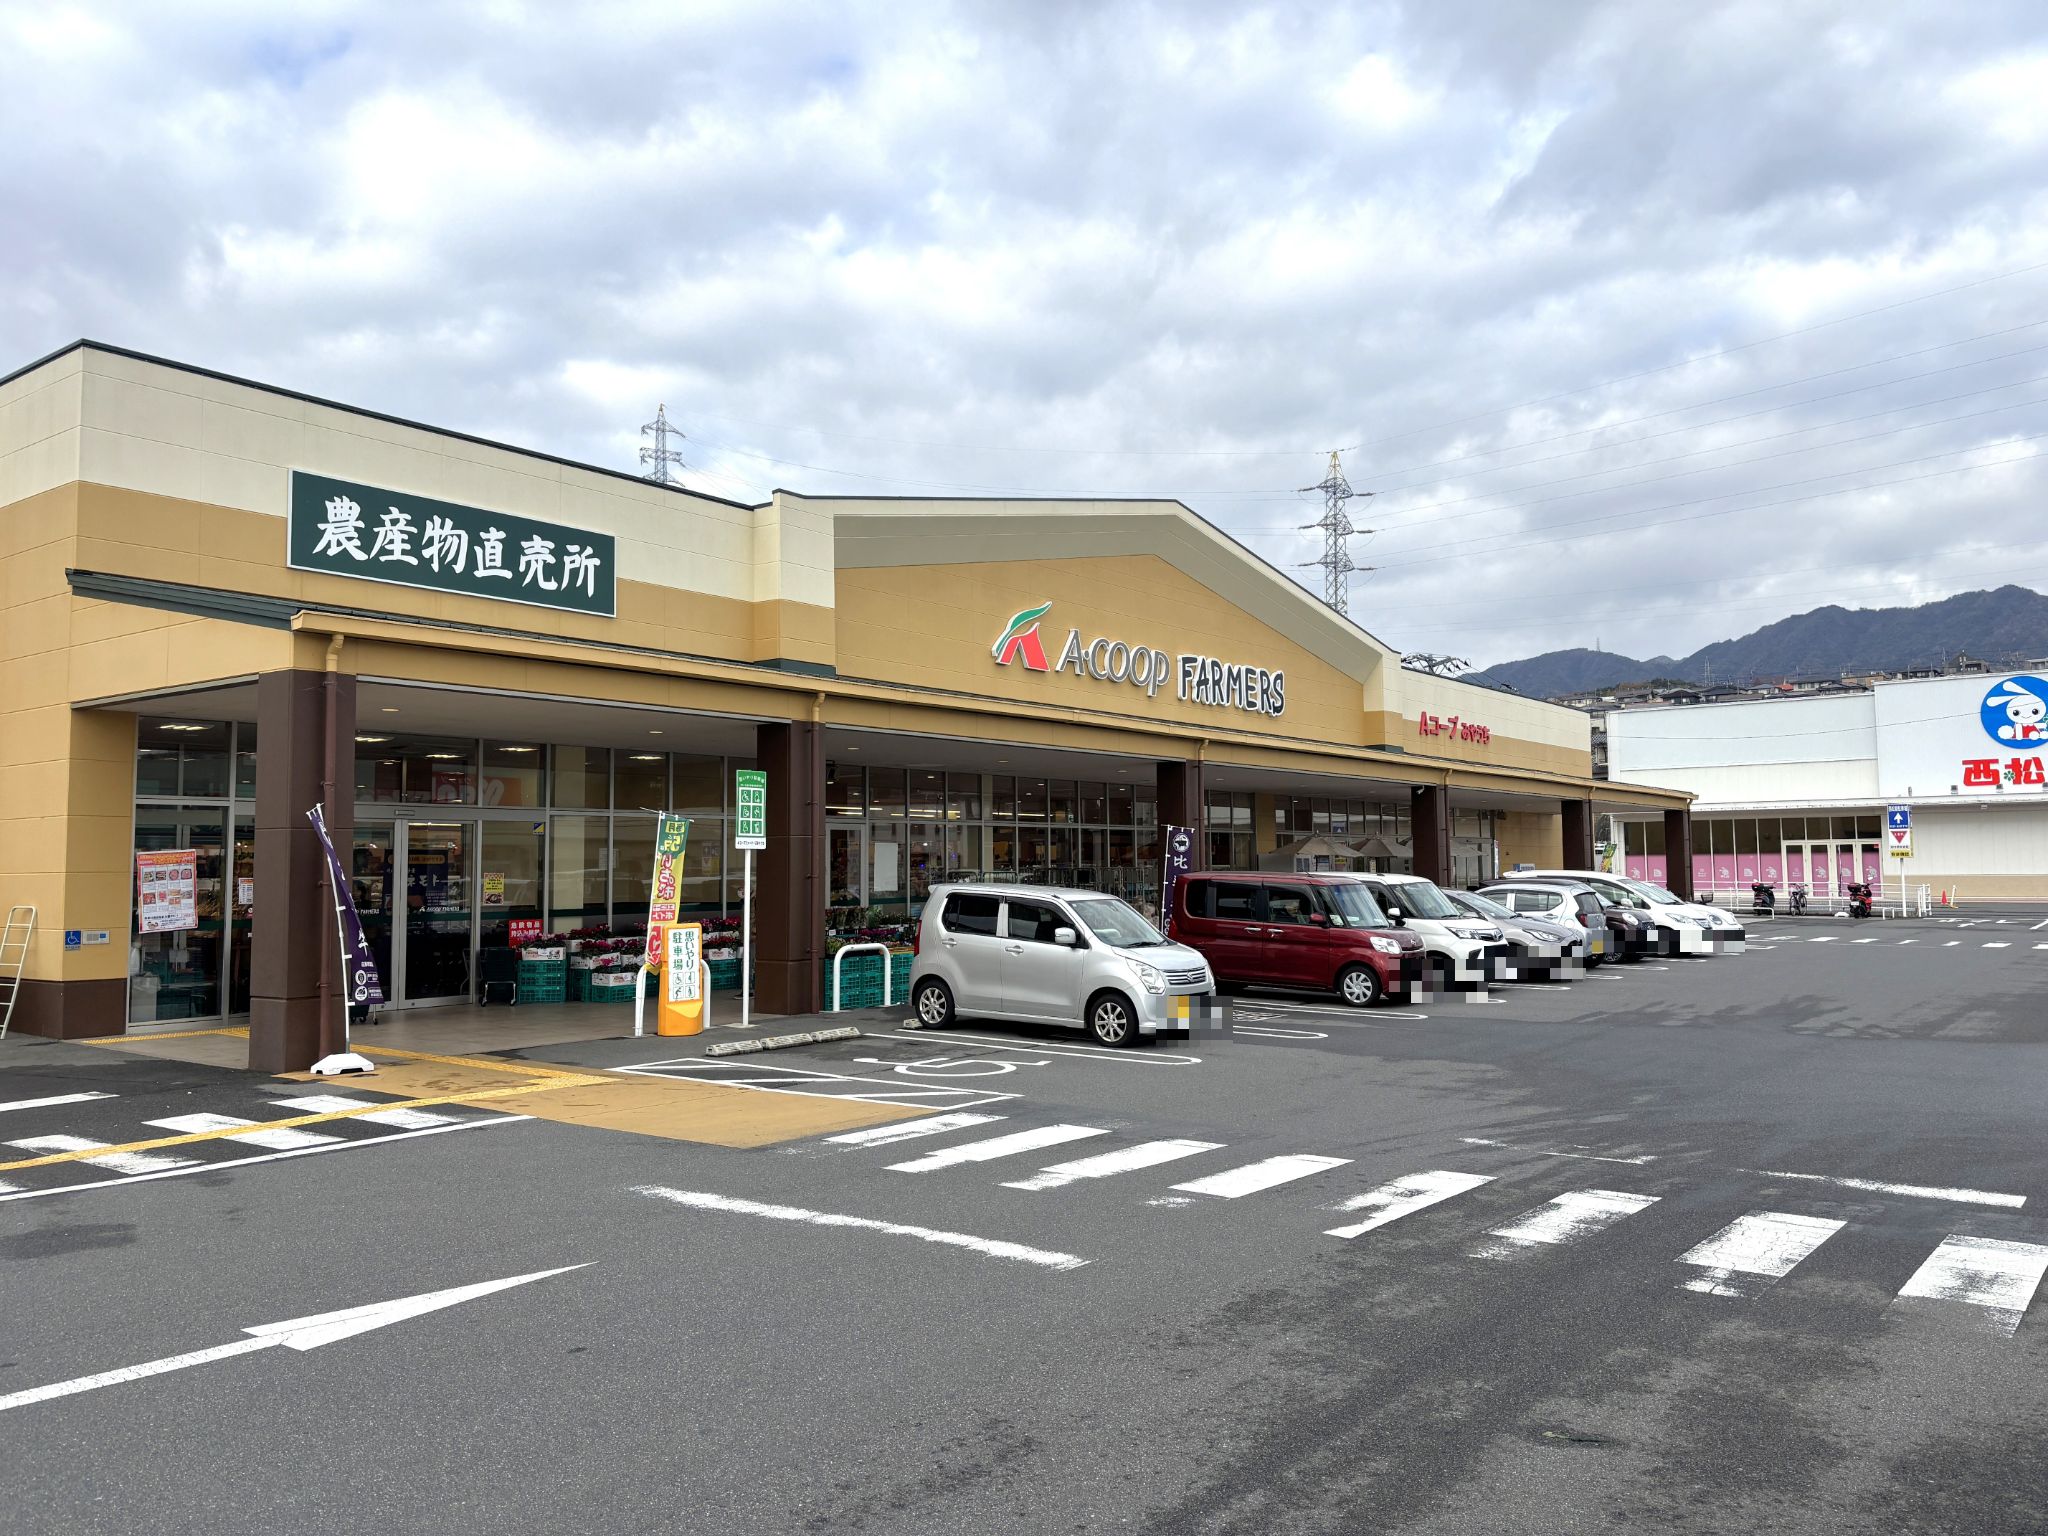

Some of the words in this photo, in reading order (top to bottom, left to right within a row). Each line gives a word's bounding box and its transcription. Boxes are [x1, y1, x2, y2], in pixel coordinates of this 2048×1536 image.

[312, 495, 601, 598] 農産物直売所
[1176, 654, 1286, 717] FARMERS
[672, 931, 683, 970] 駐車場
[684, 930, 695, 970] 思いやり
